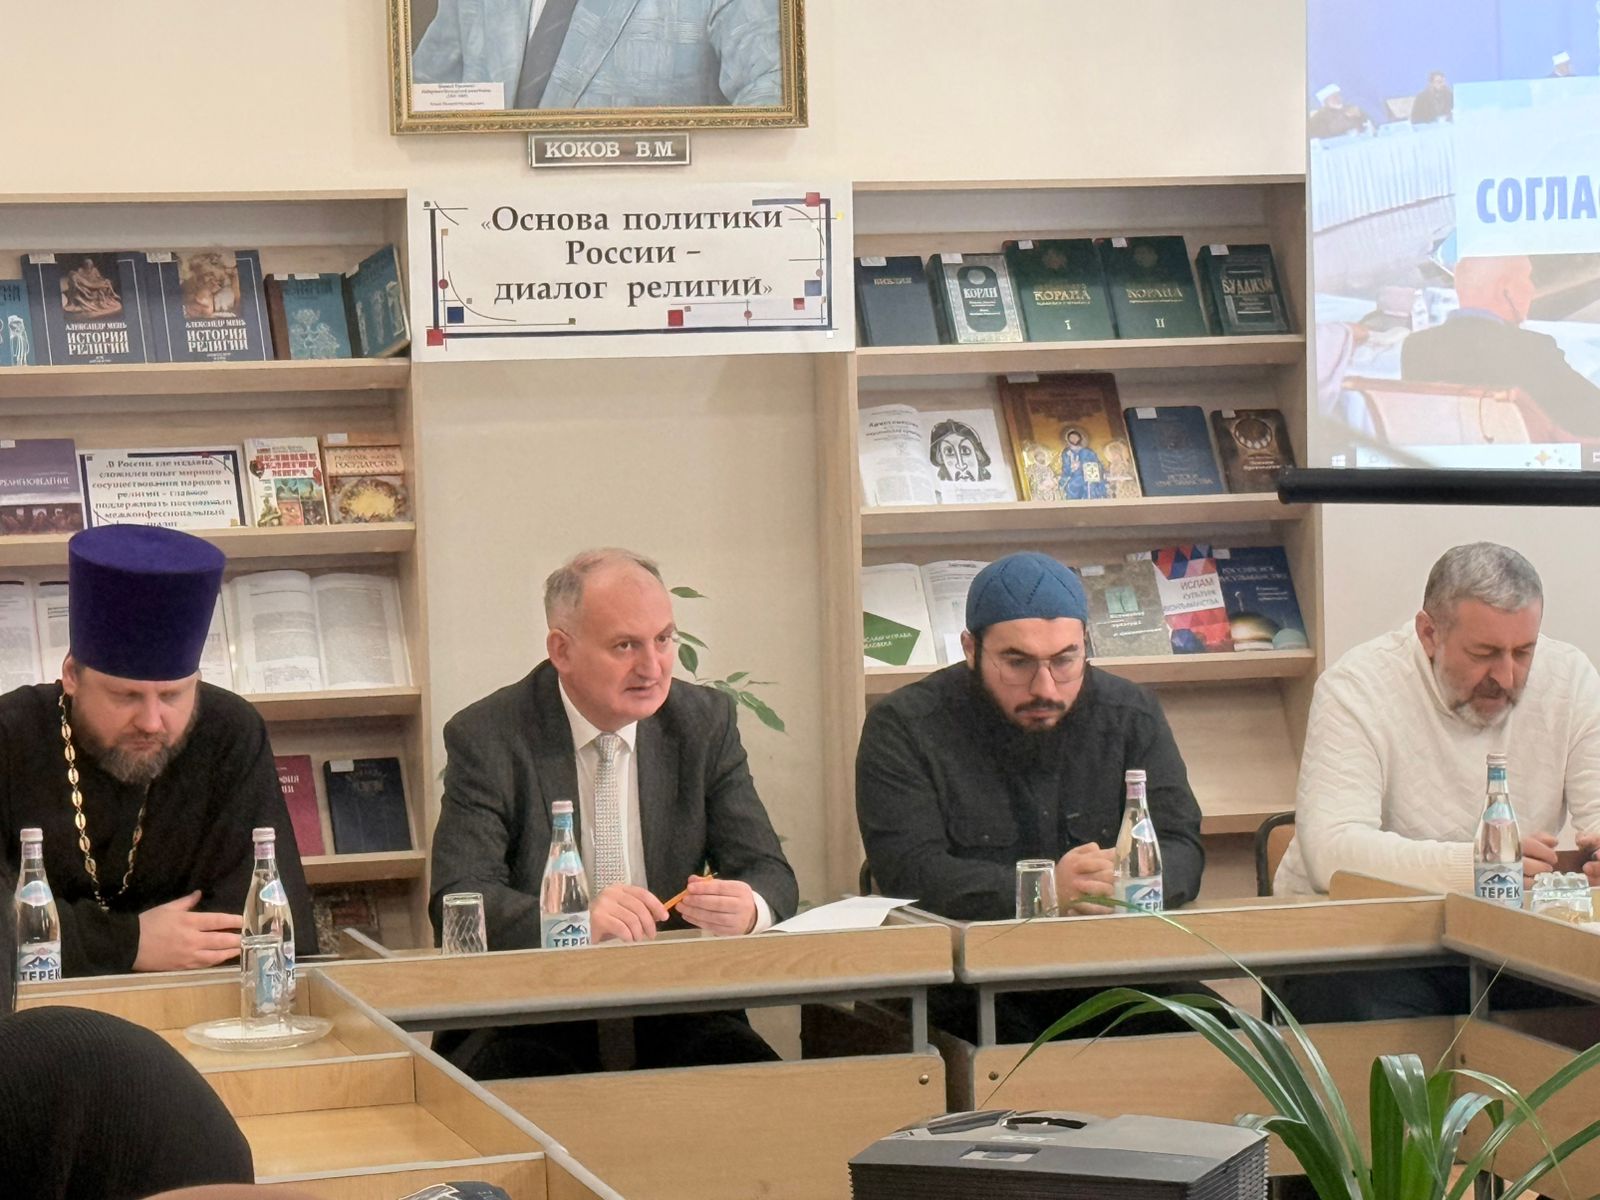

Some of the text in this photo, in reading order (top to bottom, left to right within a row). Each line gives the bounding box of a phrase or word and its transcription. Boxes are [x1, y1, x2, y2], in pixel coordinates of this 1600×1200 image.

[545, 141, 620, 158] КОКОВ
[1476, 174, 1600, 224] СОГЛА
[481, 206, 783, 233] «Основа политики
[566, 240, 676, 265] России
[494, 276, 773, 307] диалог религий»
[963, 287, 998, 299] КОРАН
[1221, 278, 1274, 295] БУДДИЗМ
[1033, 289, 1091, 301] КОРАНА
[67, 331, 128, 344] ИСТОРИЯ
[186, 328, 247, 341] ИСТОРИЯ
[68, 342, 130, 356] РЕЛИГИИ
[188, 340, 249, 353] РЕЛИГИИ
[1180, 577, 1214, 591] ИСЛАМ
[1480, 886, 1520, 898] ТЕРЕК
